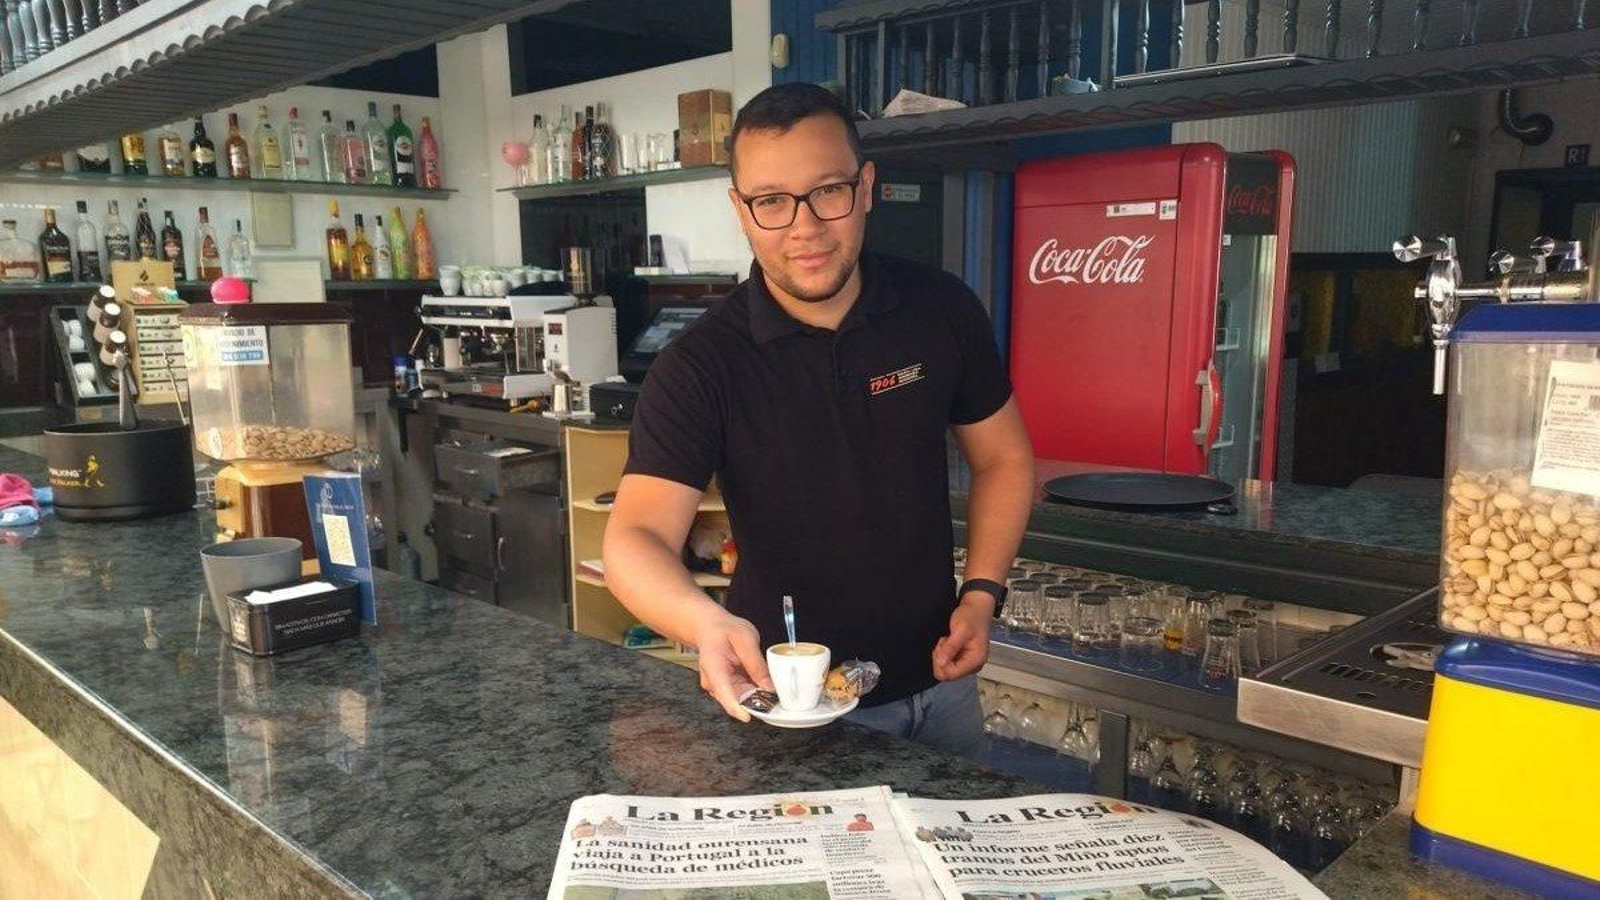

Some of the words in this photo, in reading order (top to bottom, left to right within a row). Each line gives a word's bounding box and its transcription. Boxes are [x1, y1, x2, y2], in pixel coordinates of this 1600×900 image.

[1028, 235, 1155, 284] Coca-Cola
[869, 375, 896, 391] 1906
[626, 805, 680, 821] La
[955, 809, 1015, 823] La
[574, 839, 600, 848] La
[606, 840, 692, 851] sanidad
[697, 836, 809, 848] ourensana
[933, 842, 966, 853] Un
[967, 843, 1050, 855] informe
[1054, 837, 1118, 849] señala
[1124, 833, 1166, 845] diez
[572, 850, 624, 862] viaja
[630, 853, 642, 861] a
[650, 849, 742, 863] Portugal
[748, 848, 761, 856] a
[767, 847, 786, 855] la
[940, 854, 1016, 865] tramos
[1020, 854, 1050, 865] del
[1055, 851, 1109, 864] Miño
[1114, 845, 1170, 860] aptos
[570, 860, 677, 875] búsqueda
[682, 863, 709, 873] de
[715, 856, 804, 871] médicos
[949, 866, 998, 879] para
[1002, 865, 1093, 878] cruceros
[1096, 855, 1186, 872] fluviales
